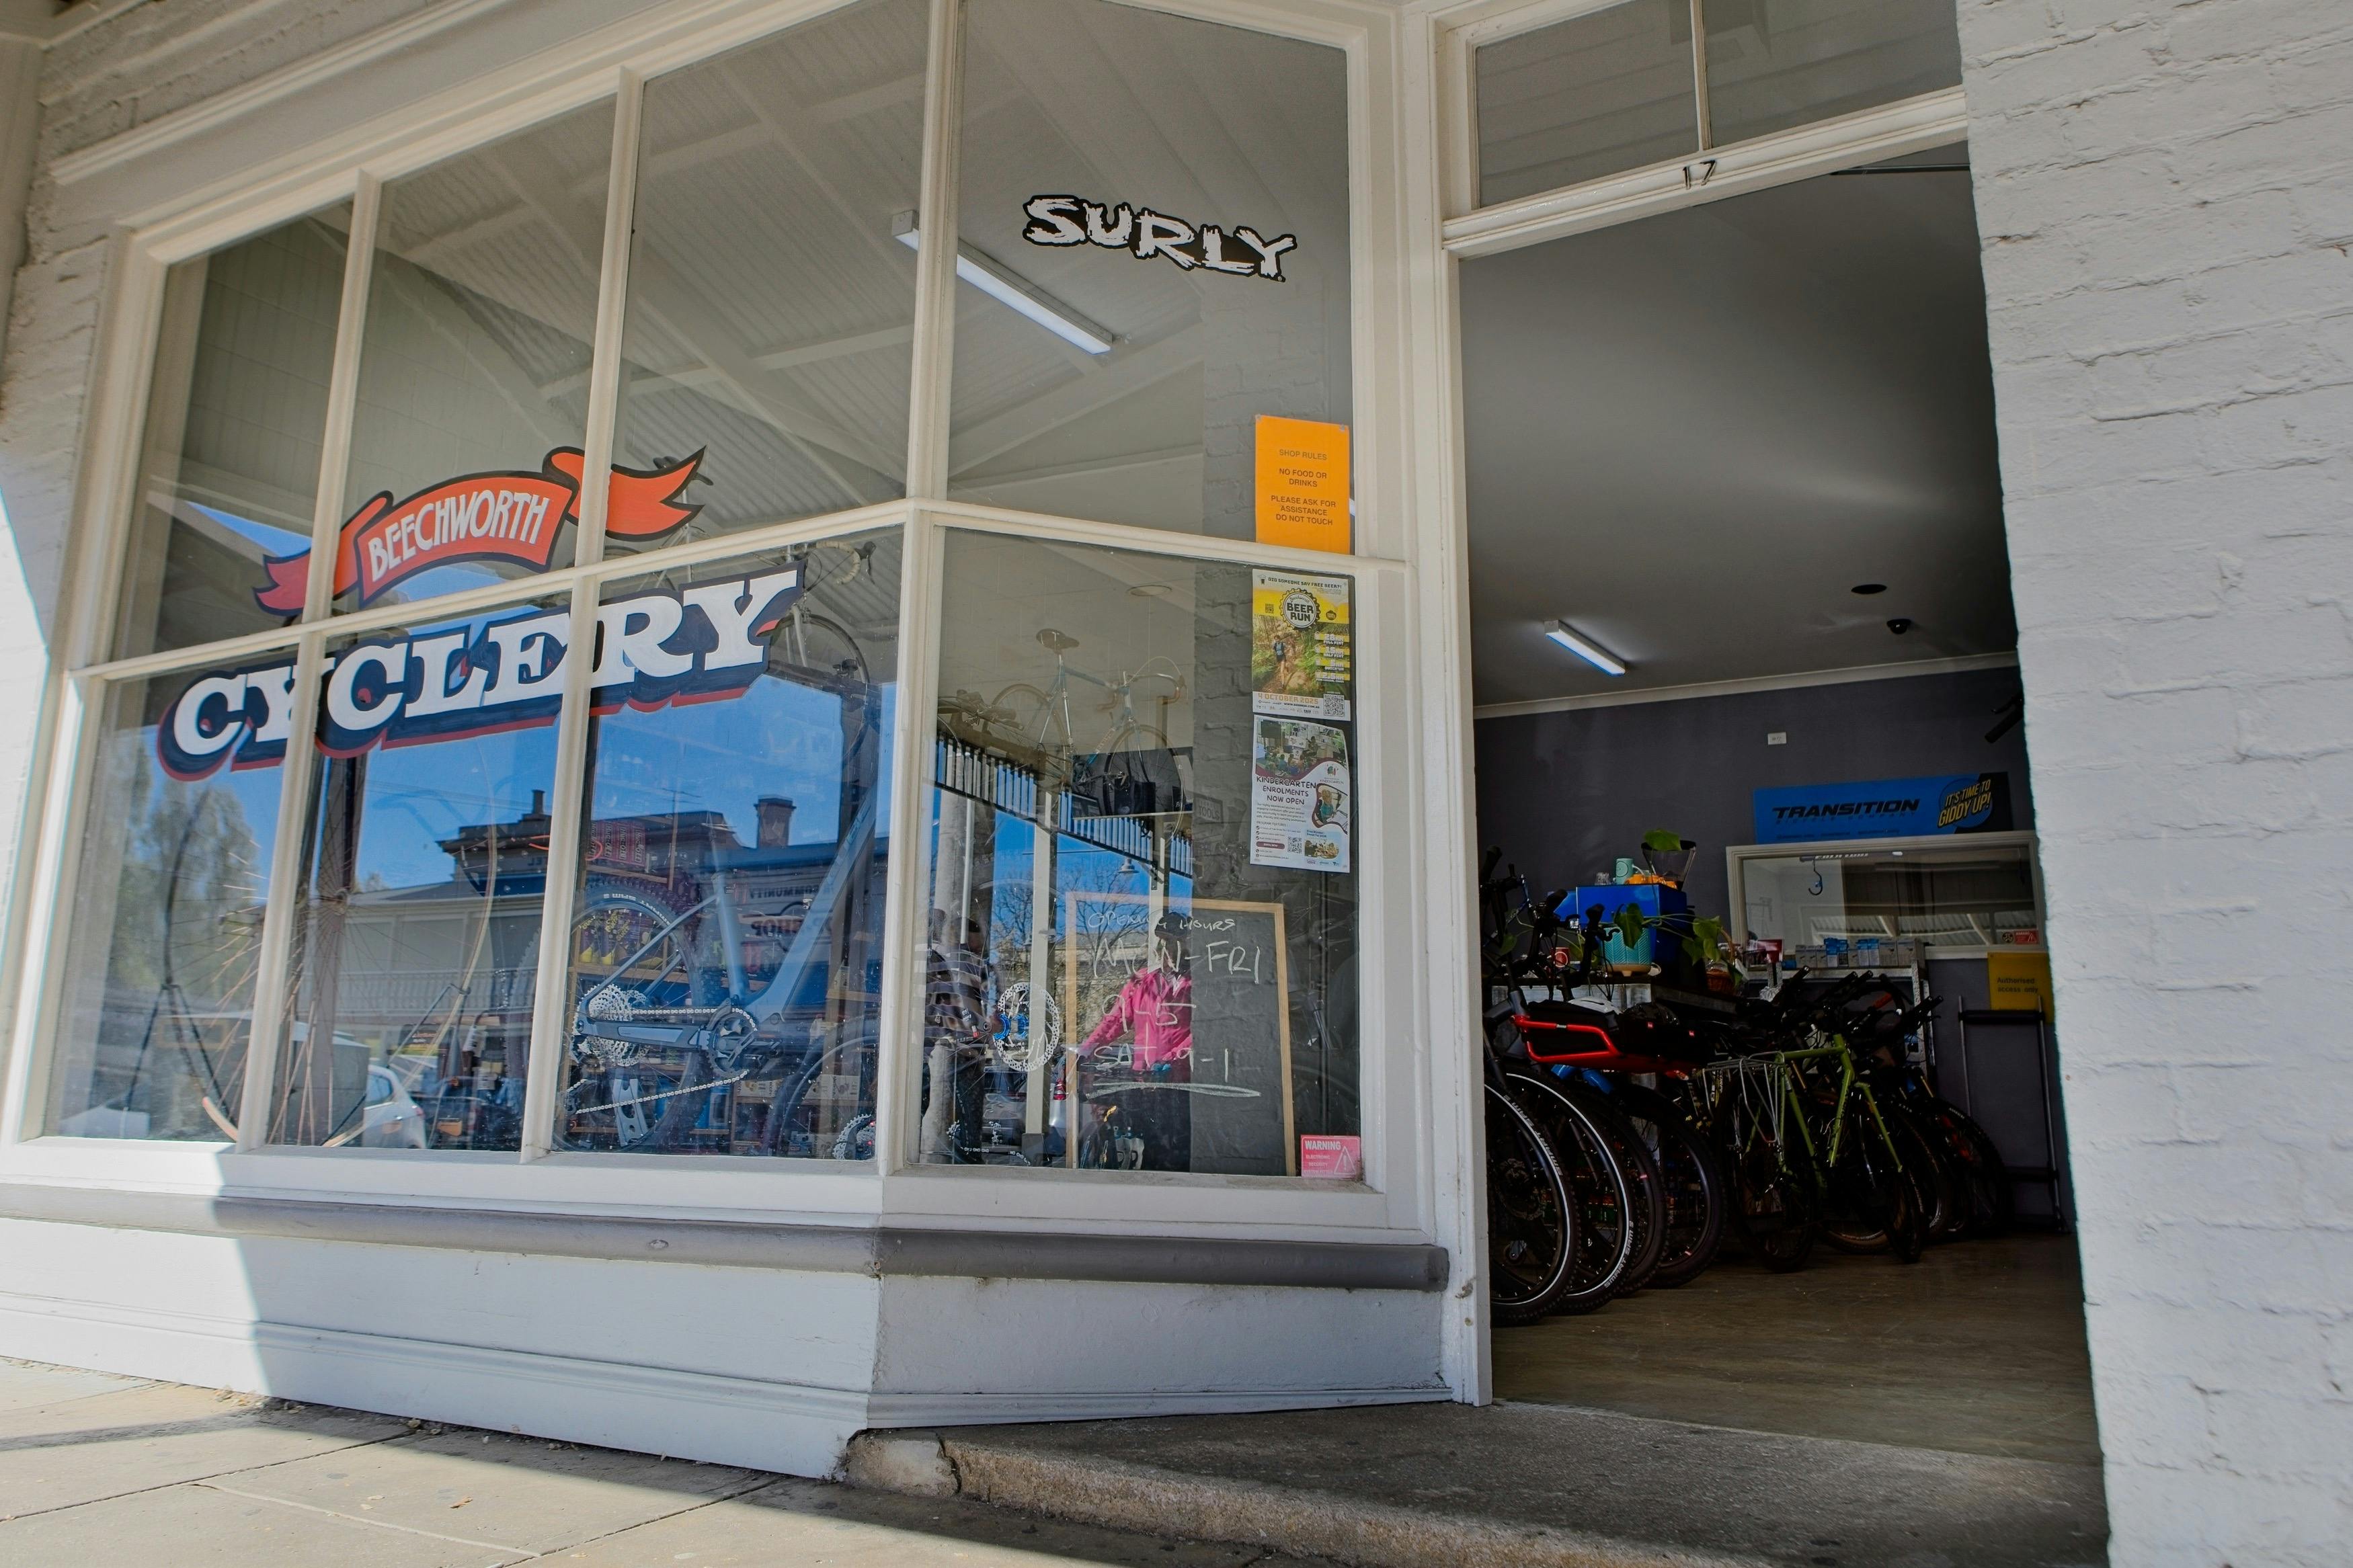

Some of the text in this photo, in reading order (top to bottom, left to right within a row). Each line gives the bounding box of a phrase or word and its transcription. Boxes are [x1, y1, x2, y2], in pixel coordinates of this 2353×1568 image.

[1683, 159, 1716, 189] 17
[1023, 196, 1297, 281] SURLY
[1279, 449, 1327, 460] SHOP RULES
[1293, 469, 1314, 478] FOOD
[1289, 479, 1318, 487] DRINKS
[1271, 495, 1301, 504] PLEASE
[1280, 505, 1327, 515] ASSISTANCE
[1306, 517, 1332, 526] TOUCH
[367, 491, 550, 579] BEECHWORTH
[1287, 603, 1314, 614] BEER
[1290, 612, 1311, 622] RUN
[169, 568, 803, 763] CYCLERY
[1265, 694, 1299, 702] OCTOBER
[1257, 776, 1316, 789] KINDERGARTEN
[1263, 785, 1309, 797] ENROLMENTS
[1945, 779, 1991, 807] IT'S TIME TO
[1285, 797, 1305, 805] OPEN
[1772, 799, 1920, 819] TRANSITION
[1938, 792, 1991, 827] GIDDY UP!
[2024, 985, 2038, 993] only
[1305, 1141, 1341, 1151] WARNING
[1604, 1229, 1634, 1288] SMART SAM
